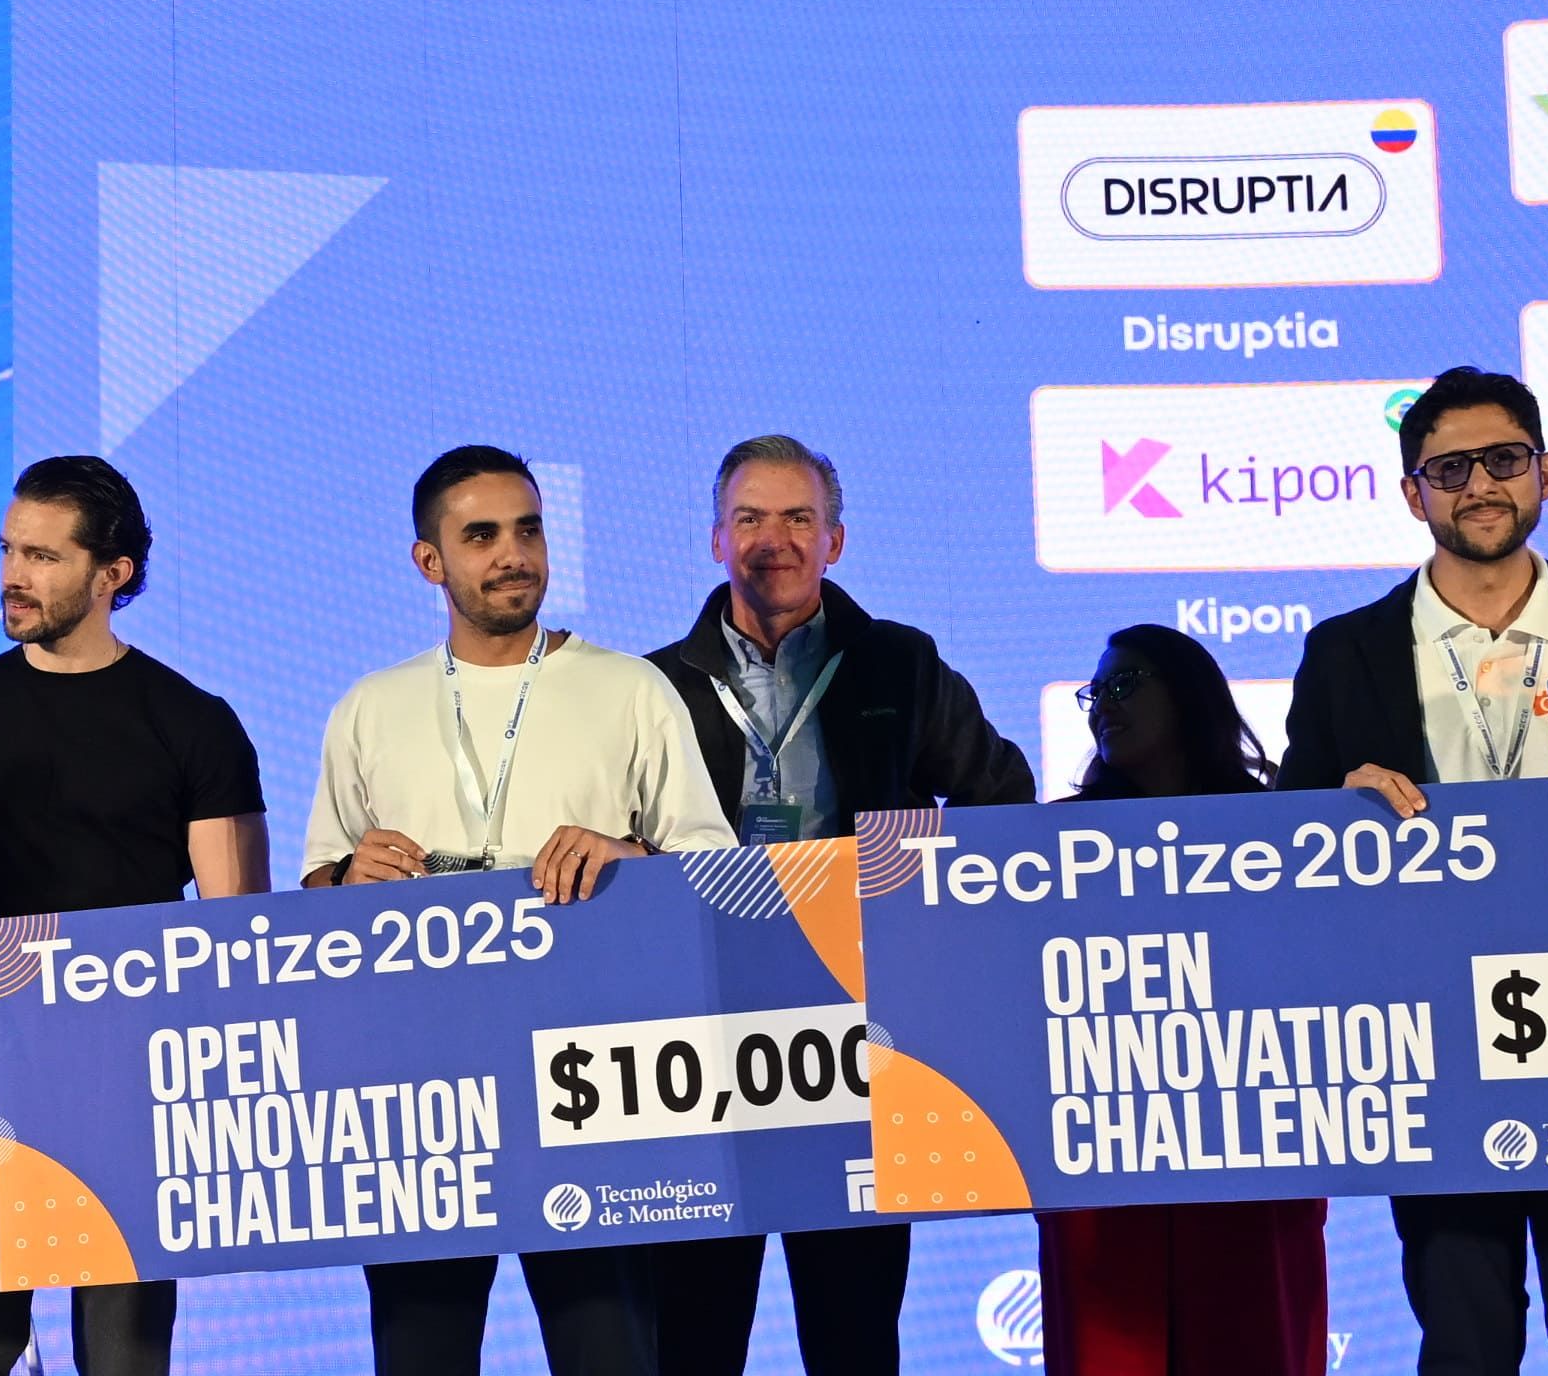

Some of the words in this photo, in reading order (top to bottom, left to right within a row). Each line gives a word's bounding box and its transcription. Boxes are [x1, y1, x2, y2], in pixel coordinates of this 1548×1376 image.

[1103, 173, 1349, 216] DISRUPTIA
[1123, 311, 1339, 358] Disruptia
[1200, 452, 1377, 517] kipon
[1176, 598, 1313, 643] Kipon
[899, 820, 1283, 906] TecPrize
[1292, 814, 1497, 889] 2025
[20, 914, 362, 1006] TecPrize
[371, 897, 555, 973] 2025
[1041, 931, 1214, 1017] OPEN
[147, 1017, 301, 1103] OPEN
[548, 1024, 871, 1130] $10,000
[1046, 1001, 1436, 1096] INNOVATION
[151, 1075, 502, 1178] INNOVATION
[1050, 1082, 1434, 1176] CHALLENGE
[155, 1149, 498, 1252] CHALLENGE
[596, 1177, 718, 1206] Tecnológico
[598, 1202, 624, 1225] de
[626, 1198, 735, 1226] Monterrey
